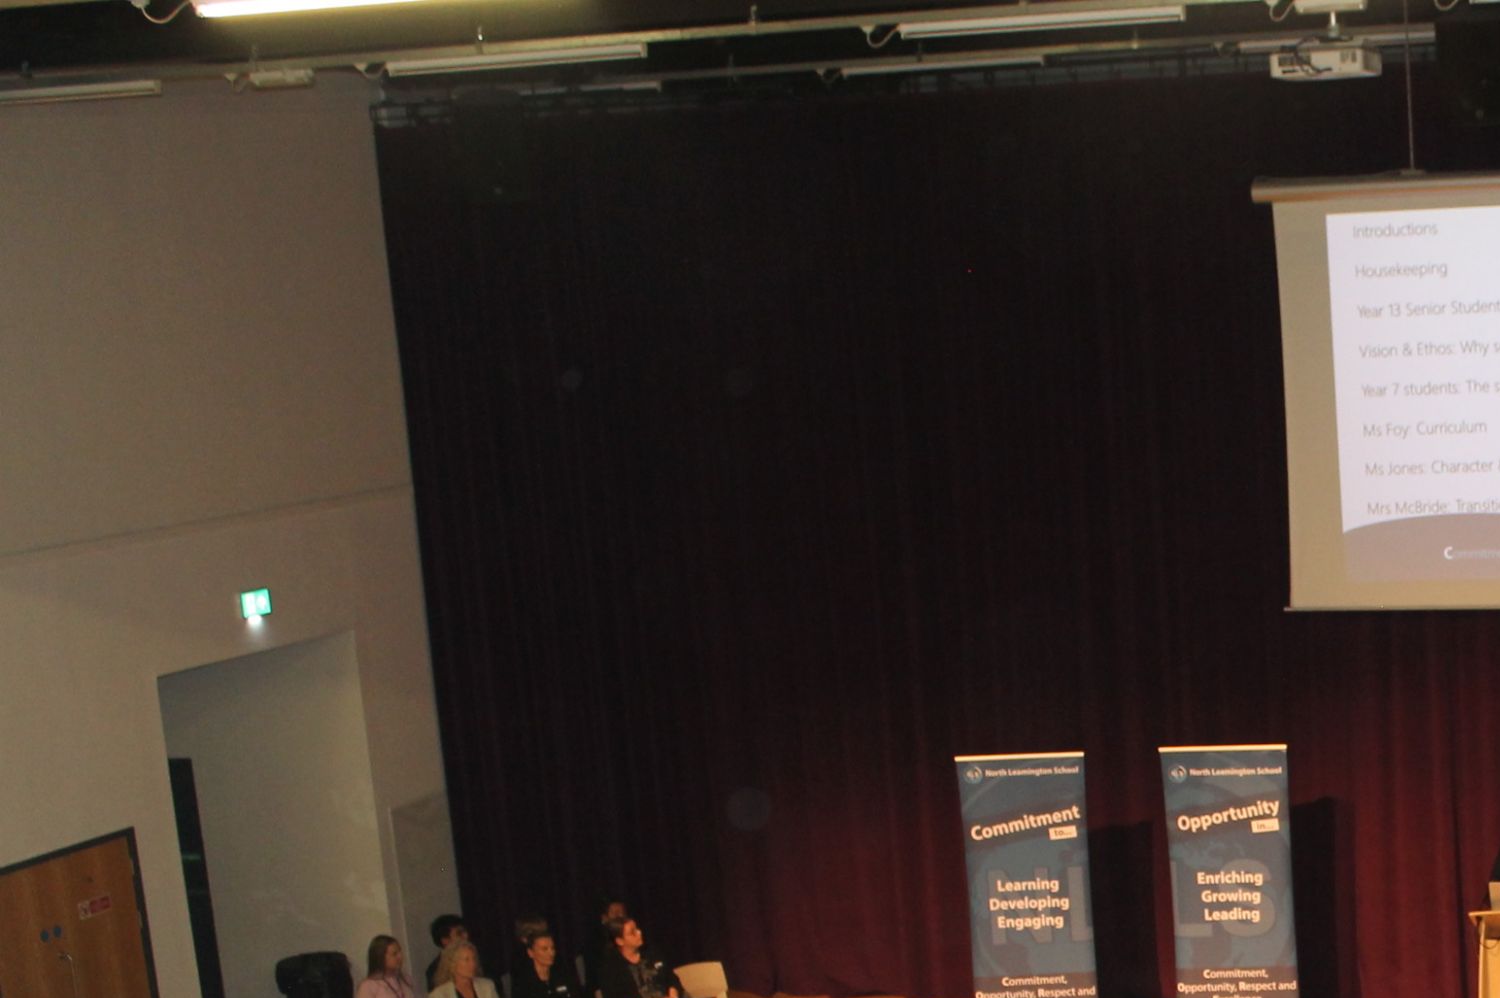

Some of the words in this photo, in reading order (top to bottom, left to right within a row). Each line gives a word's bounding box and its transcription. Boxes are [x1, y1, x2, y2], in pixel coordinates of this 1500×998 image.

[1353, 222, 1438, 239] Introductions
[1355, 261, 1447, 278] Housekeeping
[1357, 304, 1383, 318] Year
[1389, 304, 1401, 317] 13
[1406, 302, 1445, 316] Senior
[1359, 344, 1398, 358] Vision
[1402, 343, 1412, 356] &
[1460, 340, 1489, 357] Why
[1361, 383, 1387, 397] Year
[1392, 383, 1400, 395] 7
[1465, 380, 1489, 393] The
[1363, 424, 1382, 438] Ms
[1416, 421, 1487, 436] Curriculum
[1365, 463, 1384, 476] Ms
[1431, 459, 1493, 474] Character
[1368, 501, 1391, 515] Mrs
[985, 769, 1006, 777] North
[1008, 768, 1052, 776] Leamington
[1054, 766, 1079, 774] School
[1190, 768, 1210, 776] North
[1212, 768, 1256, 777] Leamington
[1257, 766, 1282, 775] School
[970, 805, 1080, 840] Commitment
[1177, 800, 1279, 832] Opportunity
[997, 878, 1059, 893] Learning
[1197, 871, 1263, 886] Enriching
[989, 897, 1070, 911] Developing
[1202, 890, 1261, 904] Growing
[997, 915, 1064, 930] Engaging
[1205, 908, 1260, 922] Leading
[1038, 987, 1075, 998] Respect
[1078, 986, 1095, 996] and
[1239, 982, 1276, 992] Respect
[1278, 981, 1296, 990] and
